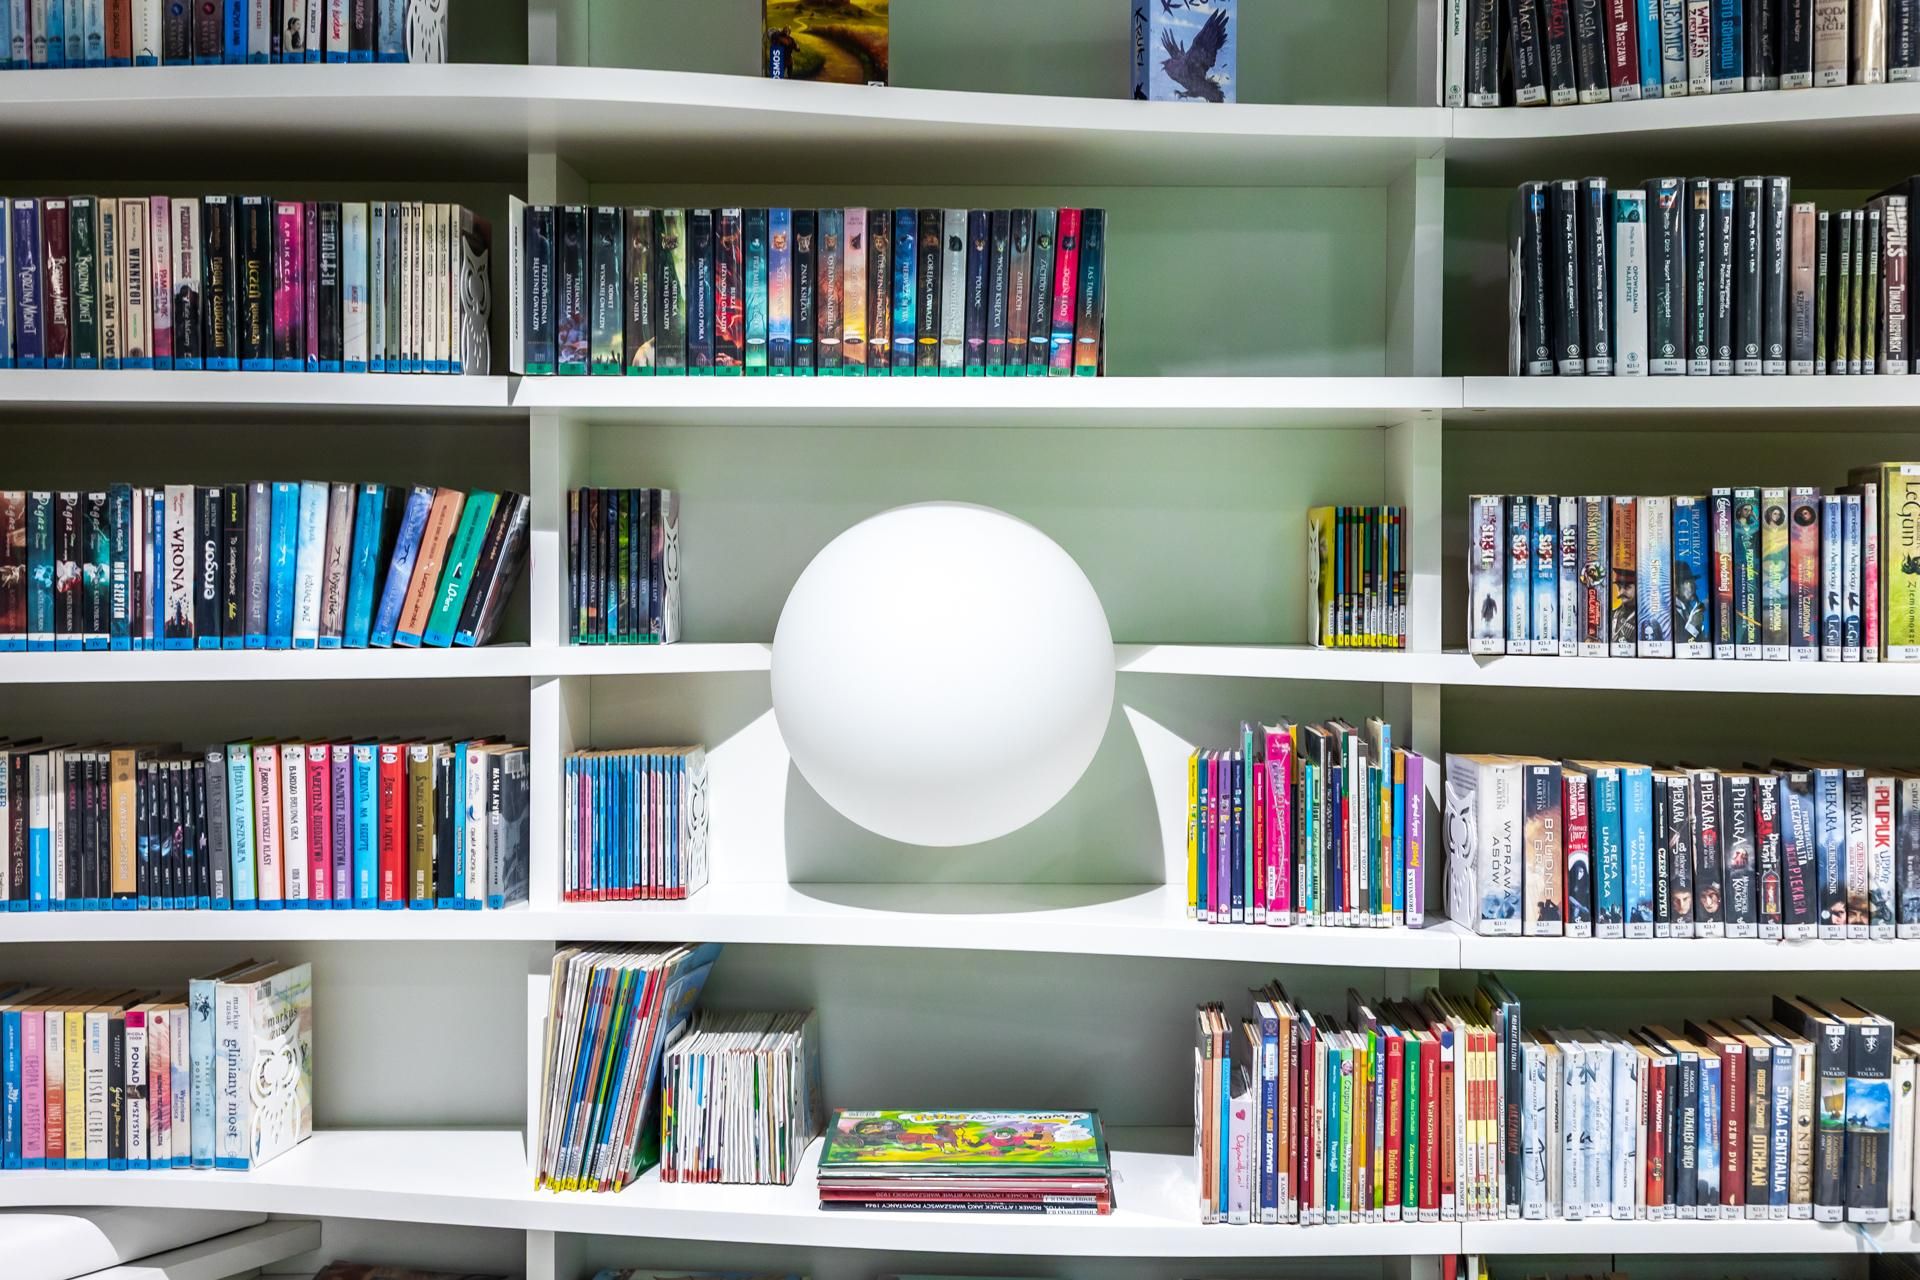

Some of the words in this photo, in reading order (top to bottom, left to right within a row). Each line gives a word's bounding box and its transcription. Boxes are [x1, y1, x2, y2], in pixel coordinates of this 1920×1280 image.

[1519, 48, 1527, 78] ANDREWS
[1615, 22, 1628, 67] WARSZAWA
[1886, 206, 1907, 258] IMPULS
[128, 248, 141, 305] WINNETOU
[248, 260, 264, 298] UCZEŃ
[531, 257, 540, 295] BŁĘKITNEJ
[800, 263, 808, 281] ZNAK
[1039, 259, 1048, 290] ZACHÓD
[540, 264, 548, 325] PRZEPOWIEDNIA
[573, 277, 581, 315] TAJEMNICA
[800, 282, 809, 321] KSIĘŻYCA
[1015, 271, 1024, 312] ZMIERZCH
[1036, 292, 1046, 323] SŁOŃCA
[1085, 282, 1094, 319] TAJEMNIC
[1889, 284, 1905, 312] TOMASZ
[532, 296, 540, 332] GWIAZDY
[598, 297, 606, 330] GWIAZDY
[662, 297, 670, 330] GWIAZDY
[1889, 314, 1906, 353] DUSZYŃSKI
[1586, 501, 1600, 561] KOSSAKOWSKA
[1678, 519, 1691, 557] CIEŃ
[114, 561, 127, 581] MÓW
[170, 527, 185, 593] WRONA
[203, 540, 218, 600] eragon
[1718, 553, 1732, 592] Grodzkiej
[114, 583, 125, 619] SZEPTEM
[1907, 581, 1917, 644] Ziemiomorze
[258, 767, 271, 804] ZBRODNIA
[288, 765, 297, 795] BARDZO
[336, 767, 346, 812] SMAKOWITE
[492, 767, 500, 791] MŁYN
[289, 796, 298, 825] BRUDNA
[491, 794, 500, 825] CZARNY
[1672, 785, 1685, 824] PIEKARA
[1701, 783, 1715, 831] PIEKARA
[1732, 788, 1746, 846] PIEKARA
[1762, 784, 1774, 821] Piekara
[1825, 780, 1838, 833] PIEKARA
[1850, 782, 1863, 834] PIEKARA
[1874, 790, 1890, 848] PILIPIUK
[261, 805, 270, 843] PIERWSZEJ
[290, 826, 299, 841] GRA
[1789, 794, 1807, 866] RZECZPOSPOLITA
[262, 844, 271, 866] KLASY
[1492, 836, 1502, 884] ASÓW
[1503, 820, 1512, 900] WYPRAWA
[1544, 818, 1554, 898] BRUDNE
[1602, 826, 1611, 898] UMARLAKA
[1638, 827, 1646, 898] JEDNOOKIE
[1658, 848, 1667, 878] CZERŃ
[1784, 843, 1796, 867] JACEK
[1658, 879, 1667, 917] GOTYKU
[1789, 867, 1806, 915] PIEKARA
[225, 1000, 234, 1026] zusak
[232, 996, 240, 1031] markus
[91, 1038, 101, 1055] WEST
[129, 1046, 140, 1084] PONAD
[88, 1068, 104, 1104] BLISKO
[220, 1039, 241, 1097] gliniany
[47, 1103, 64, 1126] INNEJ
[131, 1100, 140, 1146] WSZYSTKO
[227, 1102, 238, 1138] most
[1683, 1107, 1694, 1144] PRZEKLĘCI
[1775, 1085, 1788, 1128] STACJA
[47, 1127, 64, 1151] BAJKI
[88, 1110, 104, 1144] CIEBIE
[1683, 1144, 1695, 1169] ŚWIĘCI
[1774, 1129, 1788, 1193] CENTRALNA
[1796, 1132, 1809, 1194] TOLKIEN
